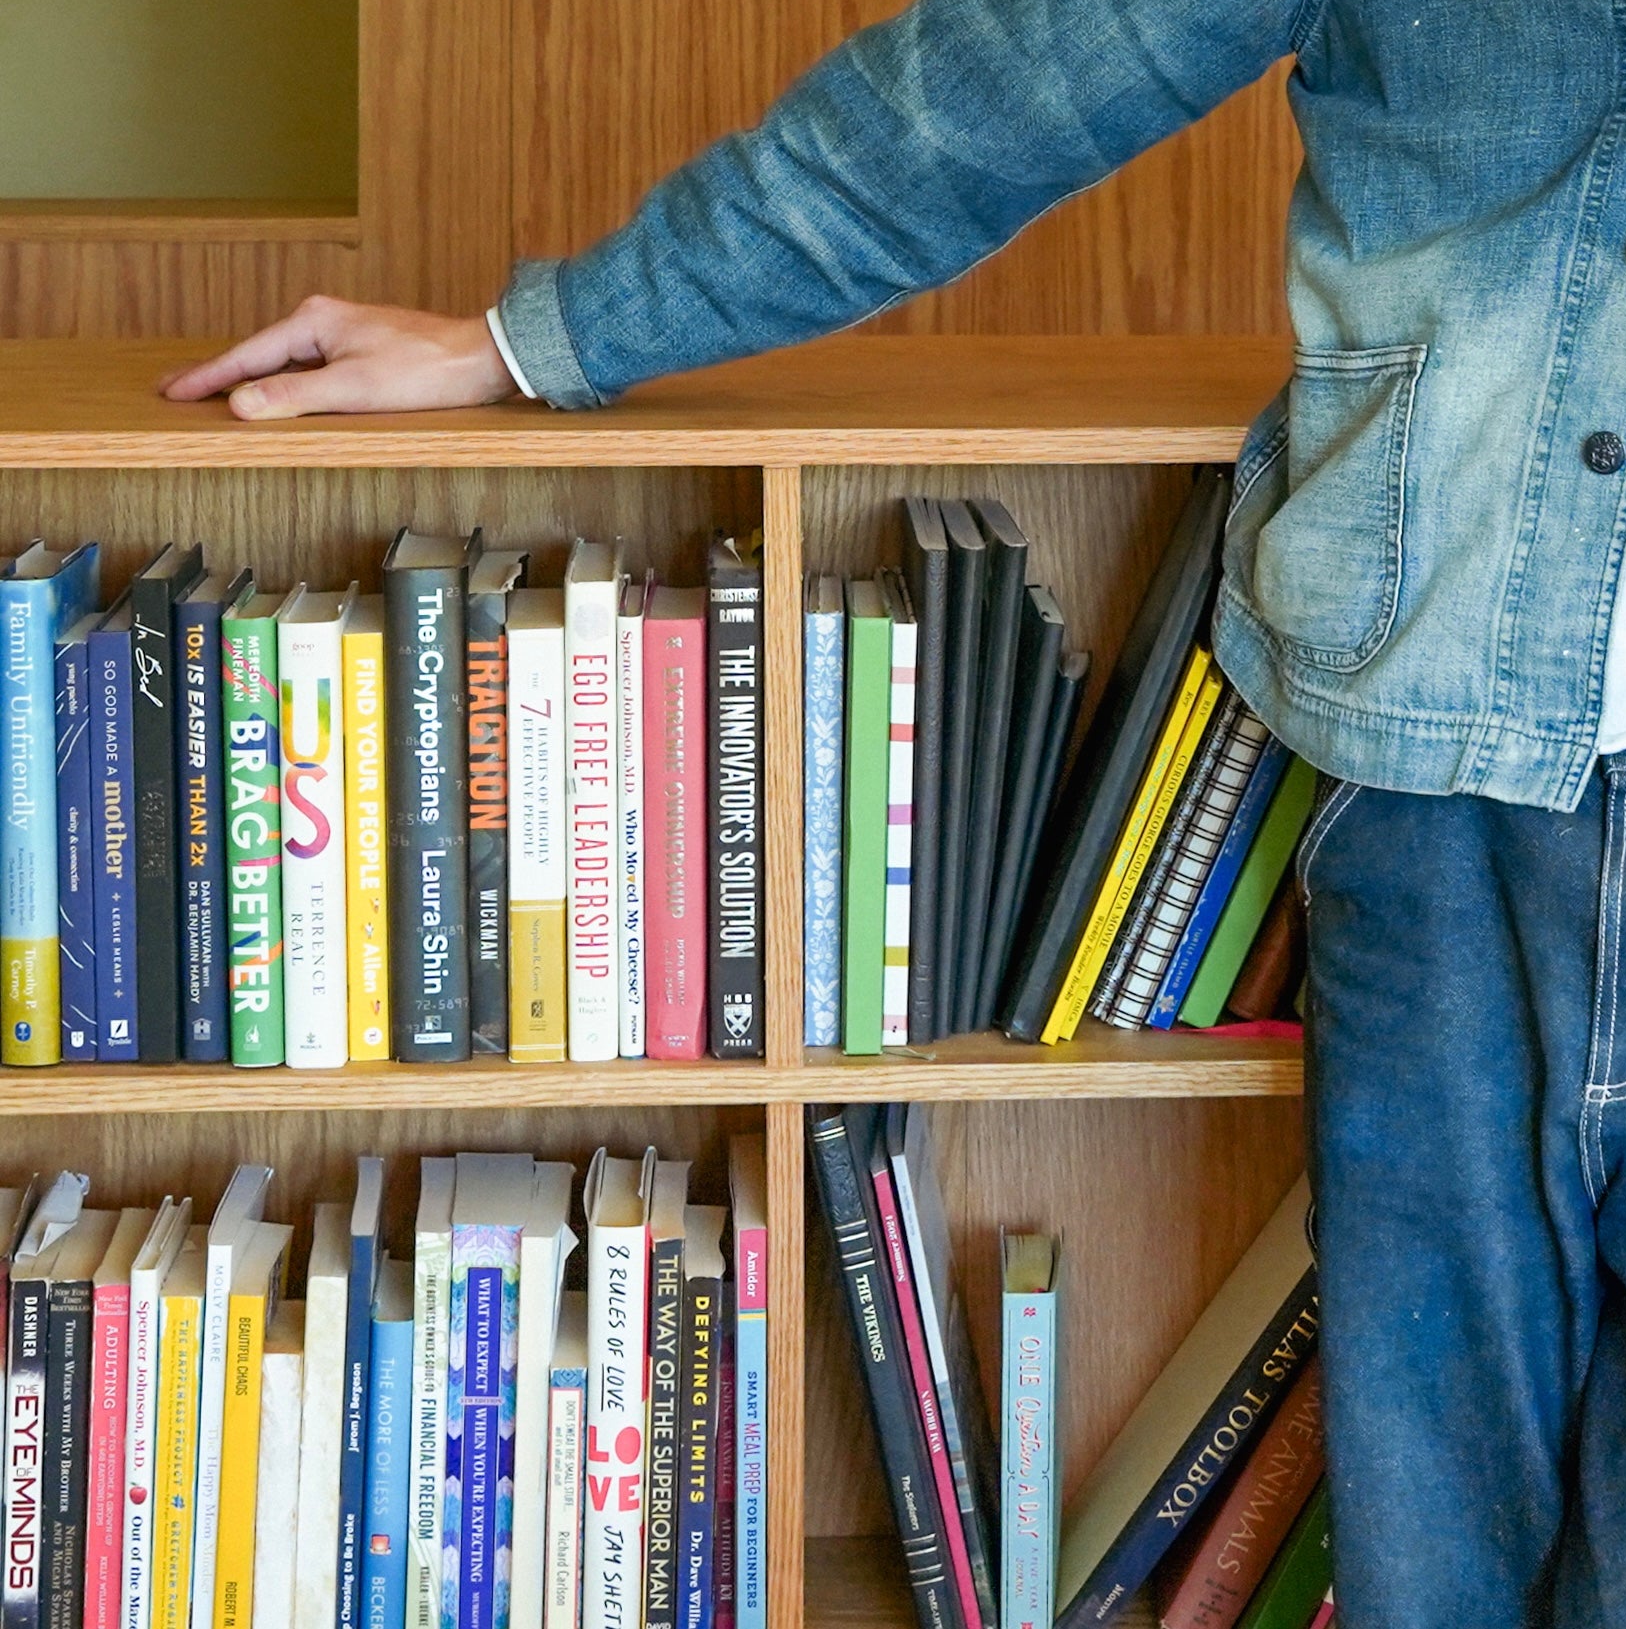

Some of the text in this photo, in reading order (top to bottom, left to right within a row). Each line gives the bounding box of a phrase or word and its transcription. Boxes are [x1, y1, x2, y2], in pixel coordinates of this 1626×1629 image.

[6, 601, 33, 686] Family
[232, 638, 243, 702] FINEMAN
[247, 635, 260, 703] MEREDITH
[573, 654, 608, 706] EGO
[7, 694, 35, 831] Unfriendly
[187, 624, 208, 866] 10x IS EASIER THAN 2x
[413, 588, 445, 822] The Cryptopians
[469, 634, 508, 829] TRACTION
[573, 722, 608, 786] FREE
[104, 660, 127, 879] SO GOD MADE A mother
[356, 658, 380, 890] FIND YOUR PEOPLE
[200, 880, 211, 906] DAN
[230, 719, 270, 1013] BRAG BETTER
[574, 804, 609, 978] LEADERSHIP
[1100, 755, 1187, 949] CURIOUS GEORGE GOES TO A MOVIE
[187, 881, 200, 1004] DR. BENJAMIN HARDY
[201, 909, 212, 964] SULLIVAN
[291, 913, 304, 967] REAL
[311, 881, 325, 996] TERRENCE
[362, 943, 382, 992] Allen
[422, 850, 449, 994] Laura Shin
[480, 889, 498, 960] WICKMAN
[22, 1296, 38, 1357] DASHNER
[606, 1245, 630, 1412] 8 RULES OF LOVE
[746, 1251, 759, 1297] Amidor
[855, 1274, 885, 1363] THE VIKINGS
[103, 1325, 119, 1409] ADULTING
[236, 1317, 251, 1396] BEAUTIFUL CHAOS
[476, 1277, 490, 1394] WHAT TO EXPECT
[1018, 1335, 1043, 1387] ONE
[13, 1395, 39, 1467] EYE
[650, 1255, 678, 1609] THE WAY OF THE SUPERIOR MAN
[690, 1296, 710, 1503] DEFYING LIMITS
[1157, 1296, 1320, 1528] ILA'S TOOLBOX
[418, 1399, 436, 1539] FINANCIAL FREEDOM
[470, 1407, 487, 1582] WHEN YOU'RE EXPECTING
[743, 1371, 761, 1608] SMART MEAL PREP FOR BEGINNERS
[1017, 1502, 1040, 1540] DAY
[1018, 1484, 1039, 1496] A
[1216, 1436, 1300, 1575] ANIMALS
[9, 1478, 37, 1589] MINDS
